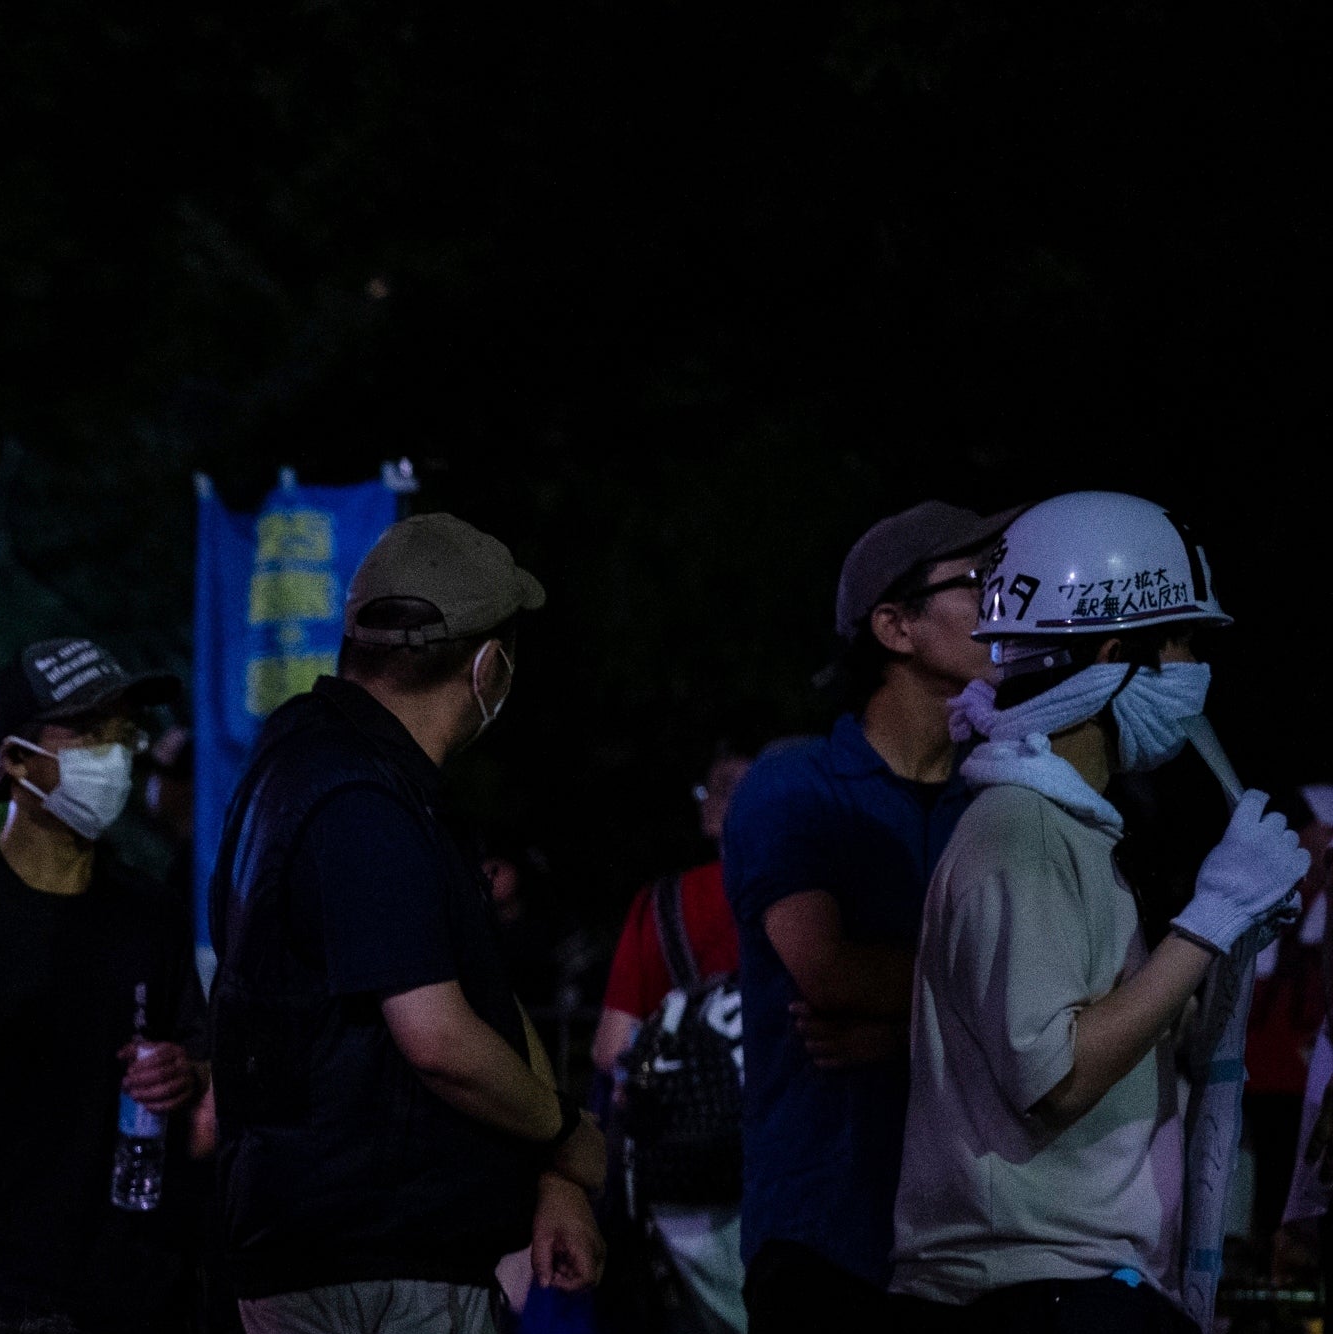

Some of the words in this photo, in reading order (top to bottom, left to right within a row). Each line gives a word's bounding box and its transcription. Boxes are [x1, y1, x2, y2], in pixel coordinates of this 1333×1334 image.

[1058, 568, 1169, 600] ワンマン拡大
[1072, 582, 1189, 618] 駅無人化反対
